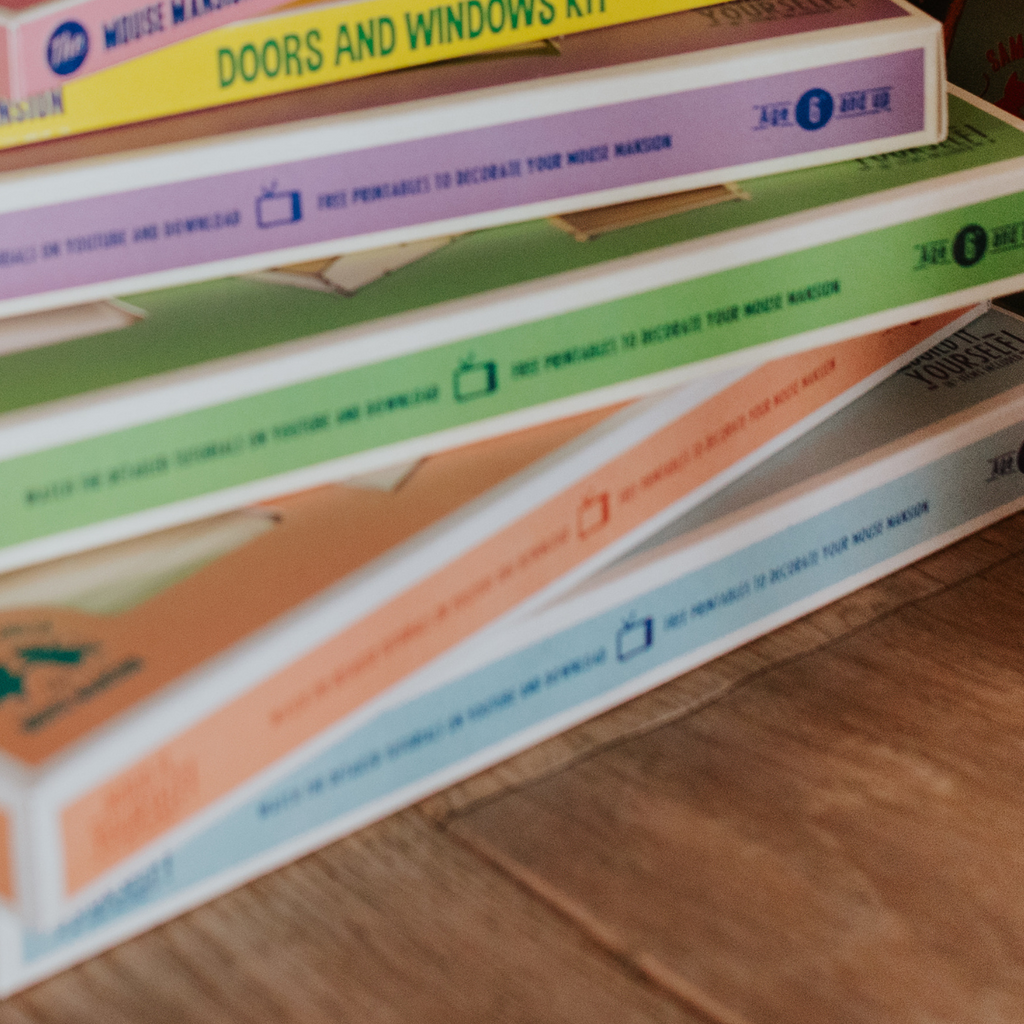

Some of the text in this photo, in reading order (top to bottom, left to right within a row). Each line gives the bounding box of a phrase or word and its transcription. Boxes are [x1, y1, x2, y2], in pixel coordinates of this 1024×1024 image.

[102, 2, 163, 51] MOUSE
[218, 29, 324, 89] DOORS
[334, 15, 396, 68] AND
[526, 152, 563, 174] YOUR
[567, 144, 610, 166] MOUSE
[613, 133, 673, 159] MANSION
[706, 305, 739, 327] YOUR
[743, 293, 783, 318] MOUSE
[787, 280, 841, 307] MANSION
[906, 329, 1024, 391] YOURSELF!
